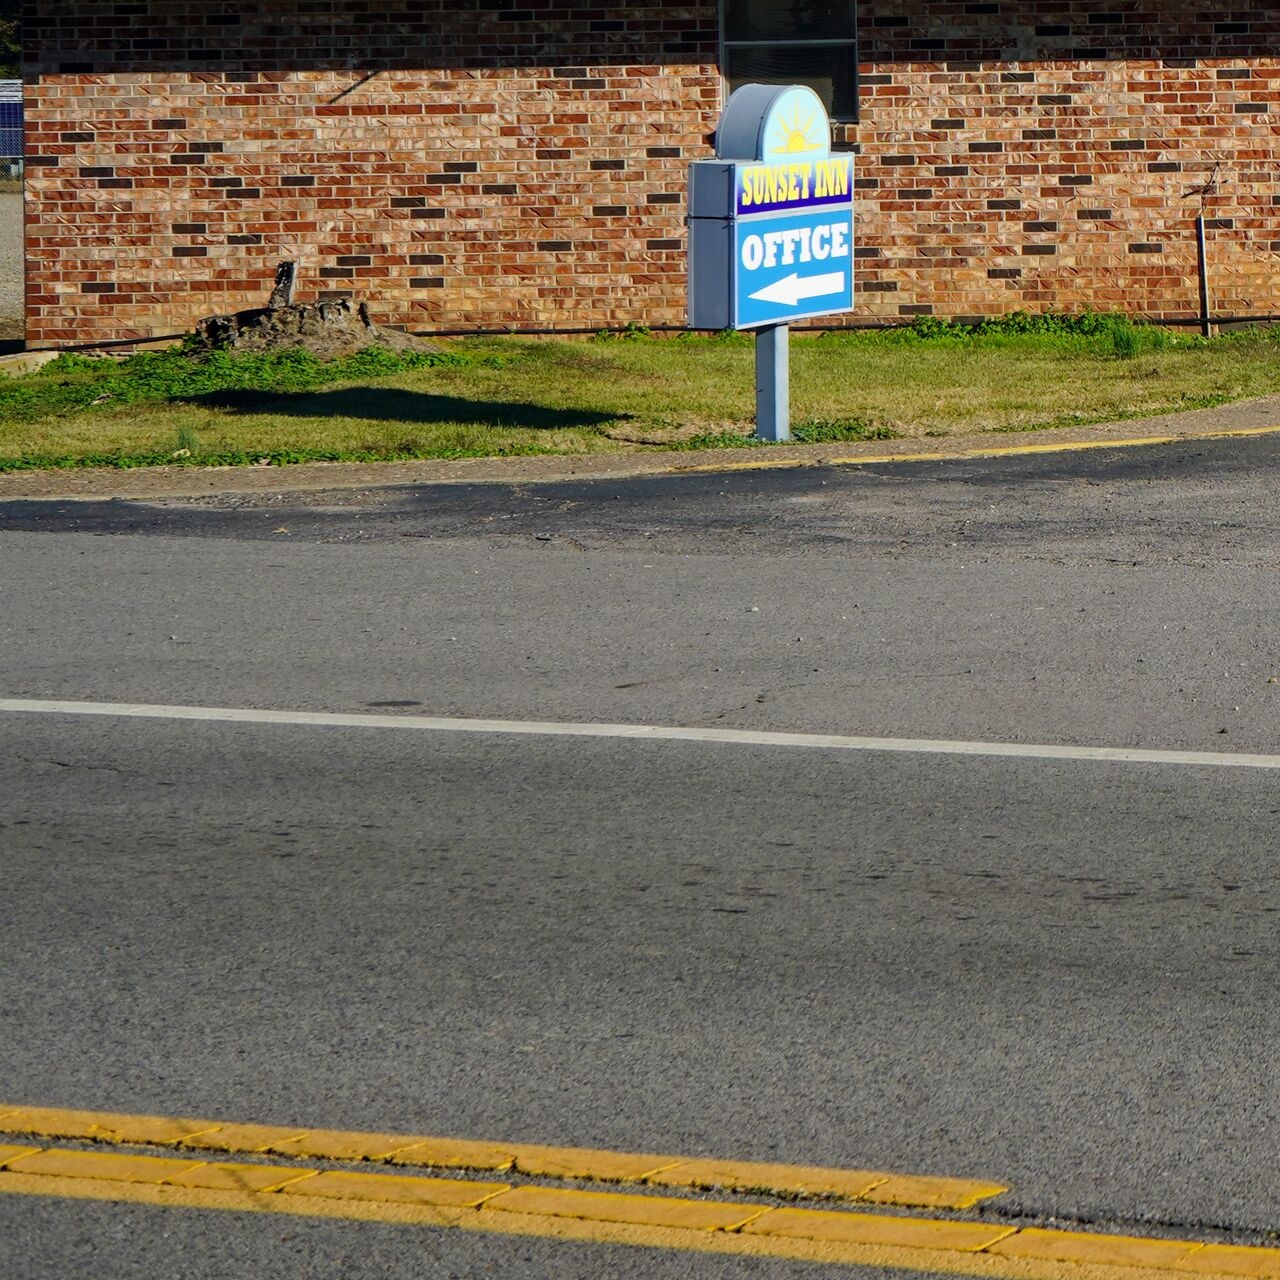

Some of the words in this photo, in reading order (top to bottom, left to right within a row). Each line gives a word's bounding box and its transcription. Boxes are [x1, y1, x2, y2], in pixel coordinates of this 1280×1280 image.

[742, 163, 811, 206] SUNSET
[814, 159, 849, 198] INN
[741, 222, 849, 271] OFFICE
